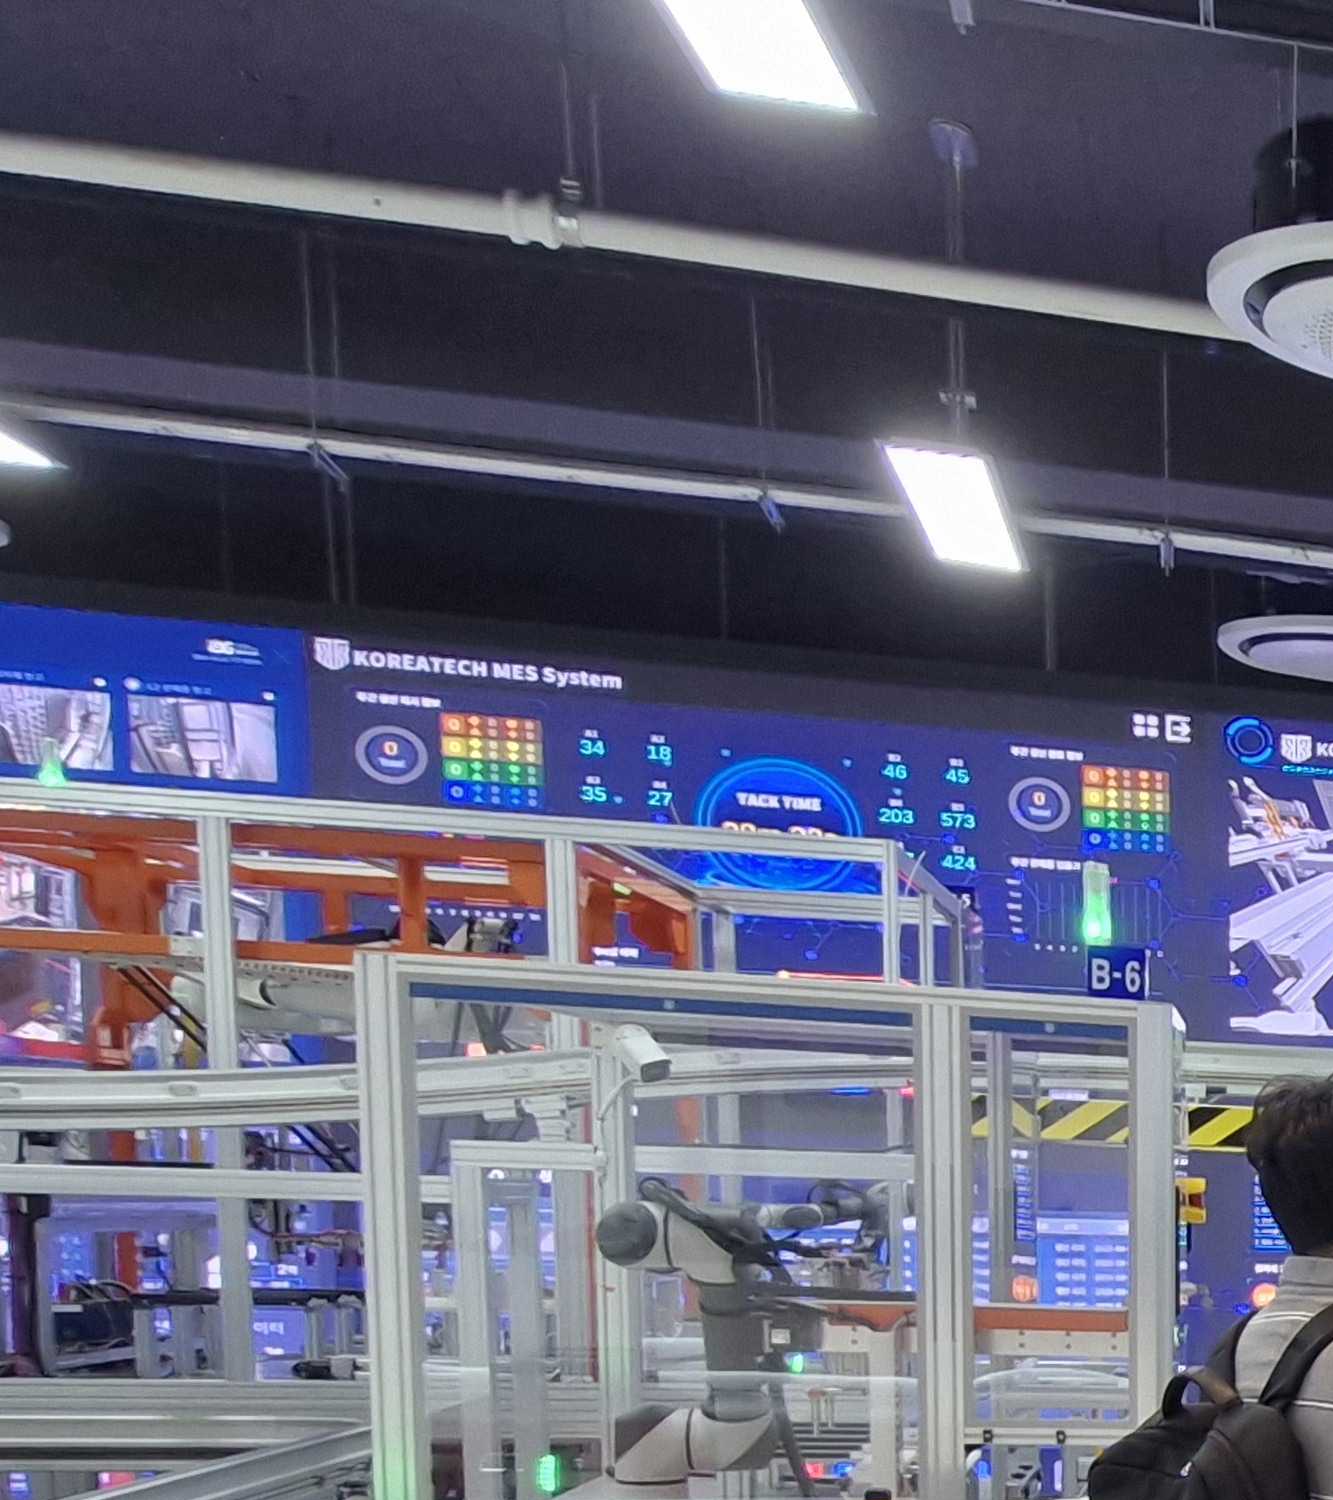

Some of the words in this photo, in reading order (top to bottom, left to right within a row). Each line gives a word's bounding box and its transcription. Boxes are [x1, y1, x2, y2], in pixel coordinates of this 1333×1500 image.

[353, 649, 488, 678] KOREATECH
[491, 661, 539, 683] MES
[542, 667, 623, 691] System
[580, 739, 605, 755] 34
[646, 745, 673, 760] 18
[881, 764, 907, 780] 46
[944, 768, 971, 784] 45
[580, 786, 607, 802] 35
[647, 790, 673, 806] 27
[879, 808, 914, 824] 203
[940, 812, 976, 829] 573
[941, 855, 977, 870] 424
[1091, 957, 1141, 993] B-6
